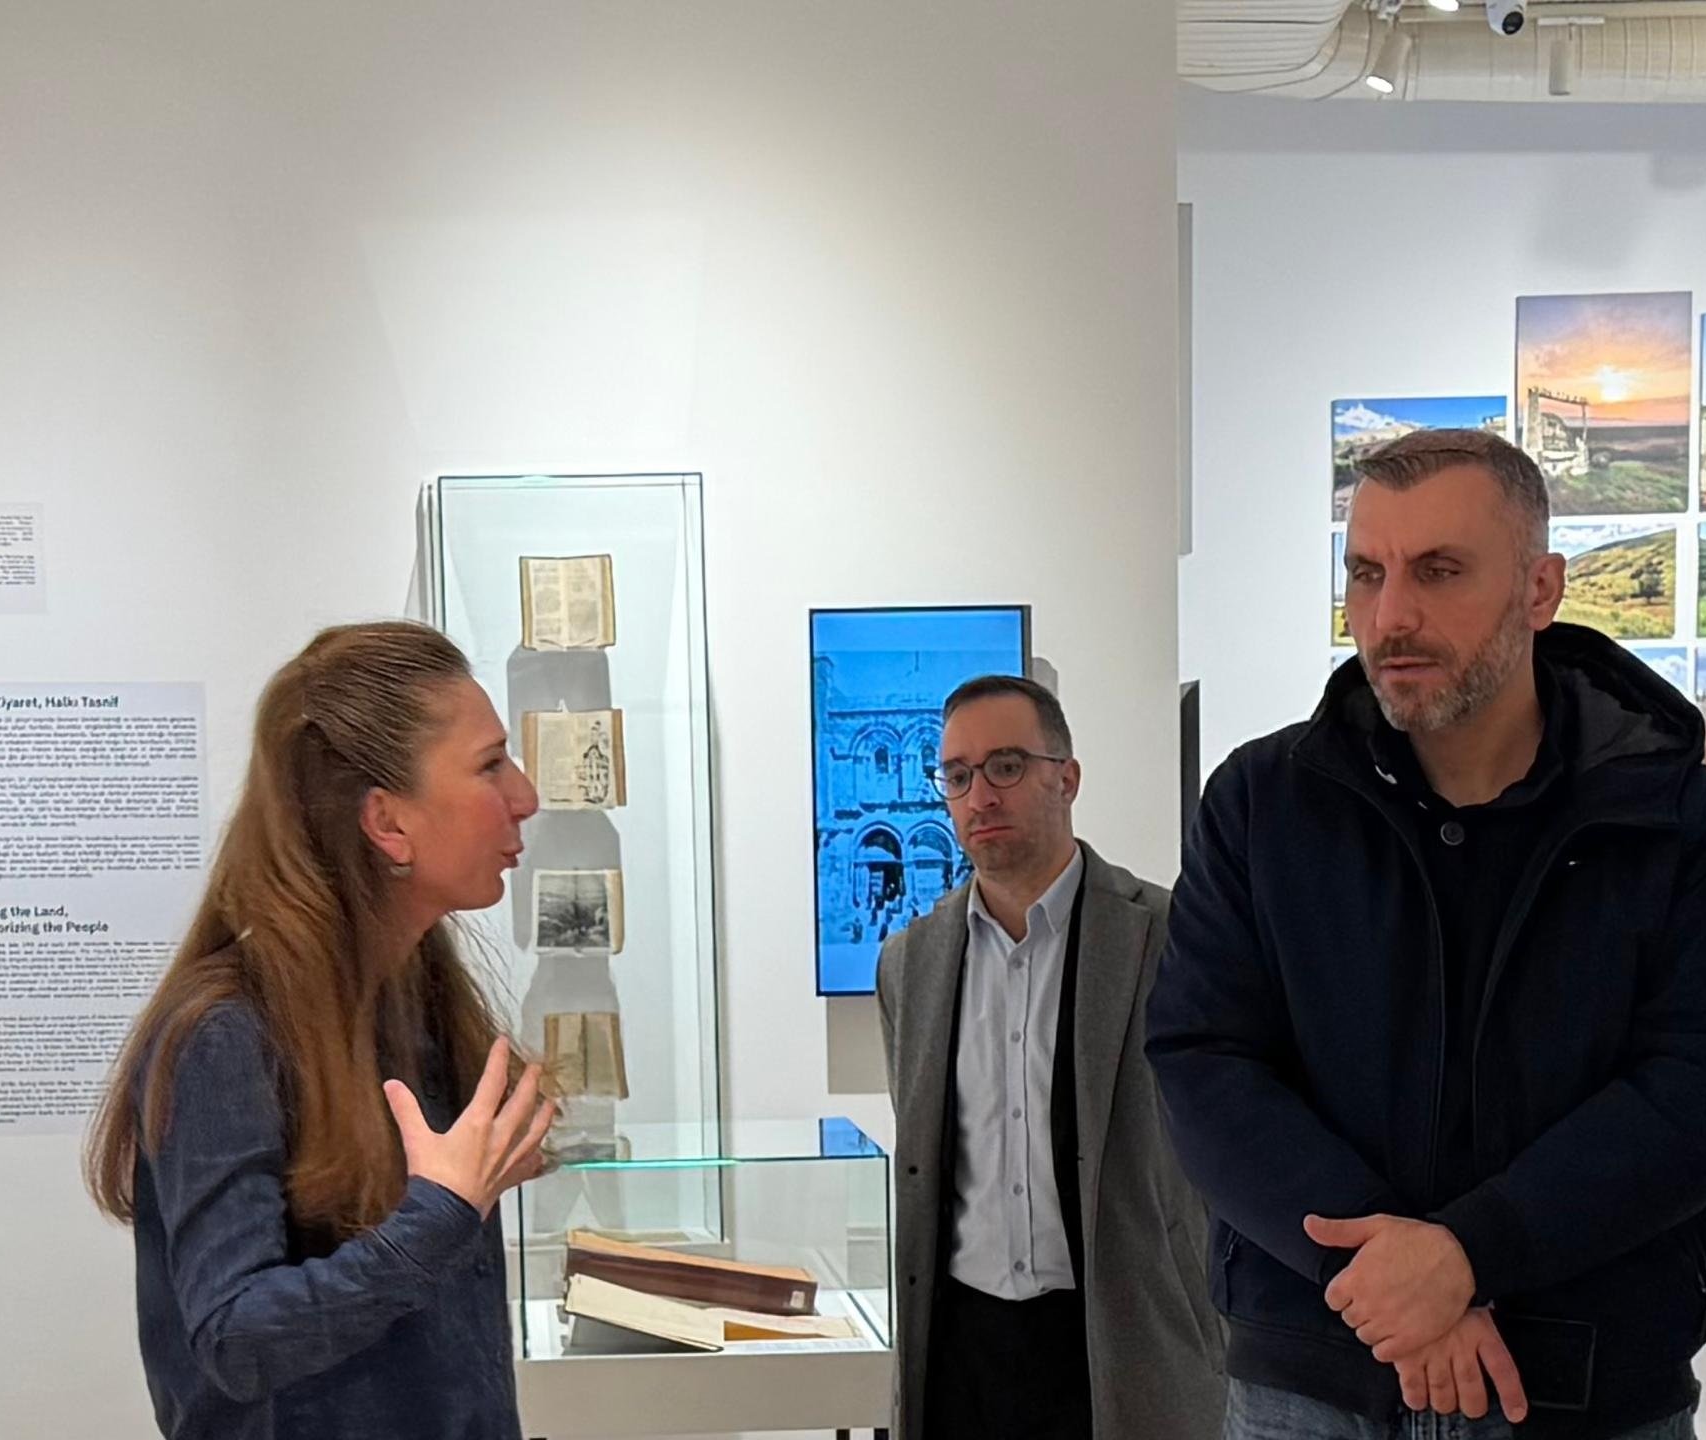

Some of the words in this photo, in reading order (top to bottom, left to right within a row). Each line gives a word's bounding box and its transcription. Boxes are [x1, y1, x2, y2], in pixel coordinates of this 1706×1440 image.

[82, 695, 119, 708] Tasnif
[10, 906, 31, 917] the
[34, 906, 68, 918] Land,
[43, 921, 62, 933] the
[66, 921, 109, 935] People
